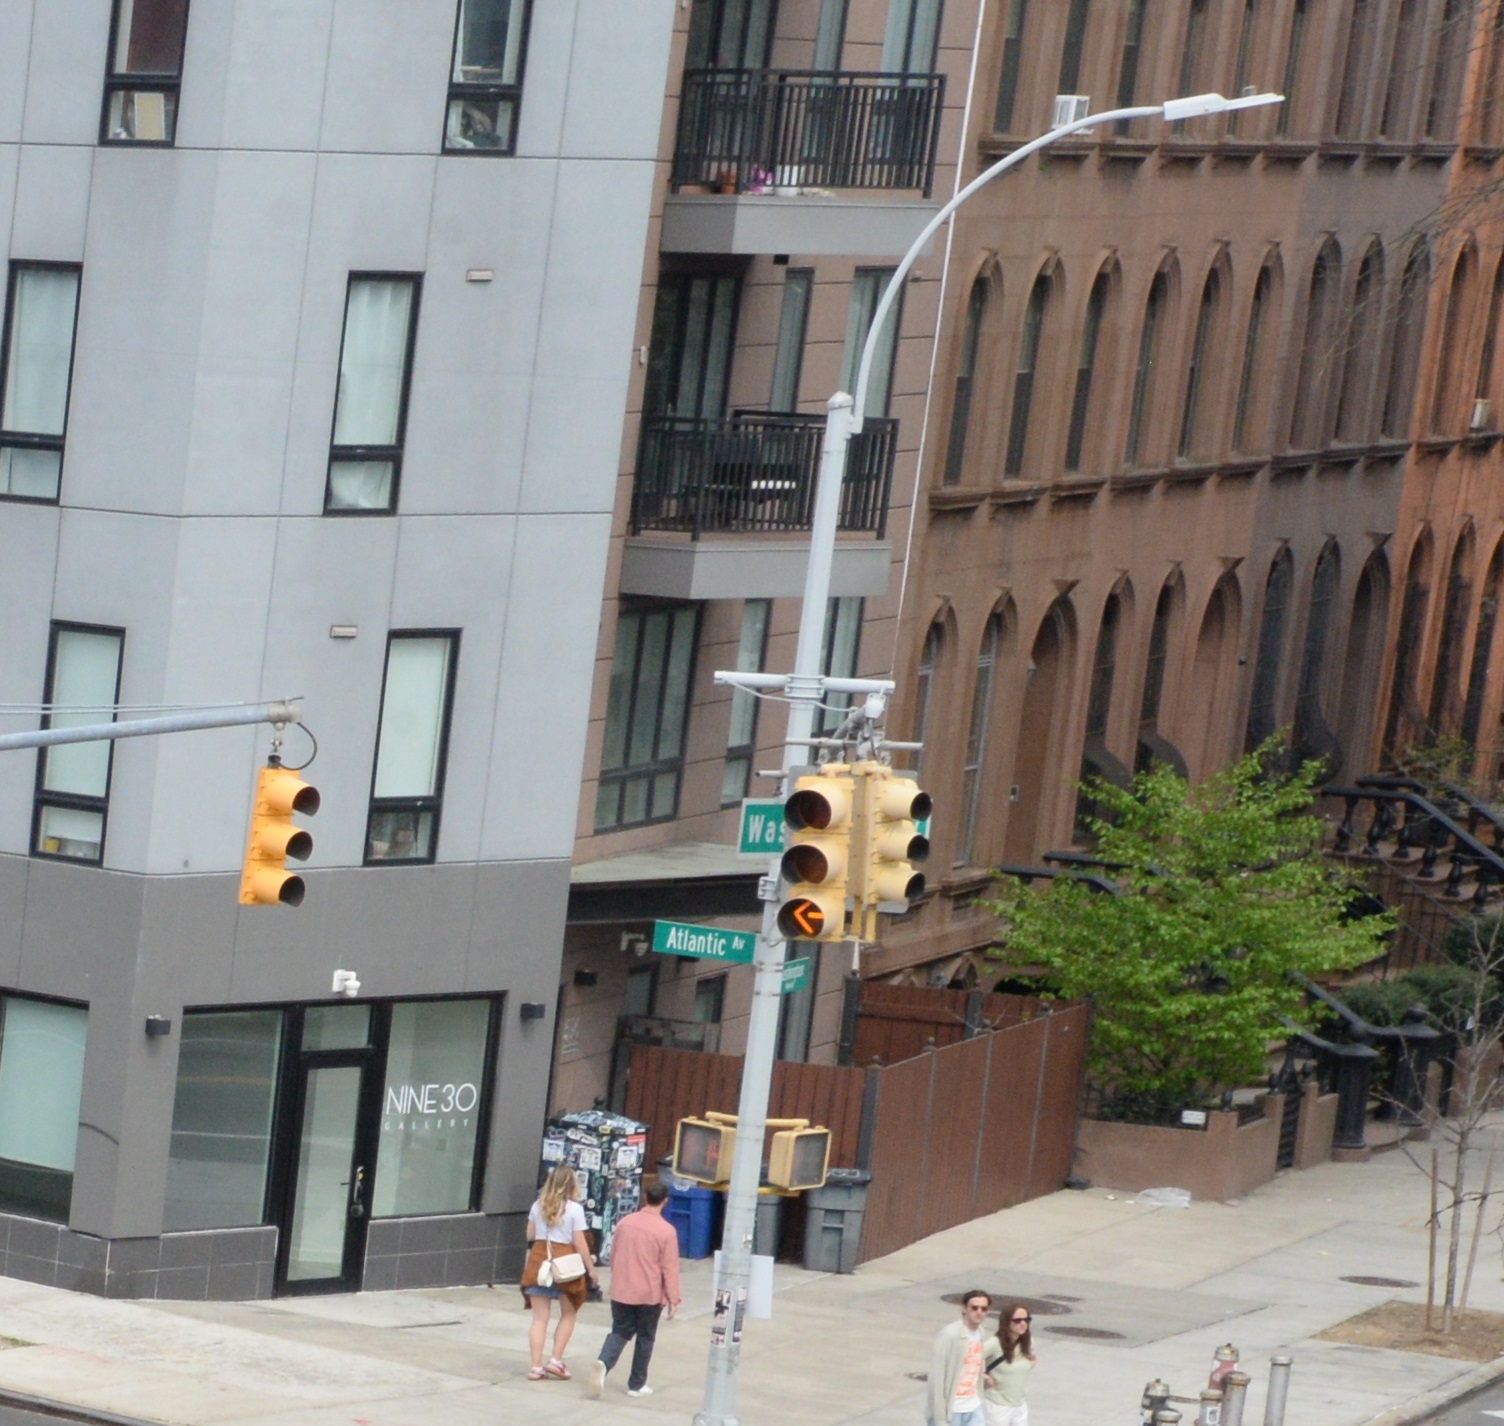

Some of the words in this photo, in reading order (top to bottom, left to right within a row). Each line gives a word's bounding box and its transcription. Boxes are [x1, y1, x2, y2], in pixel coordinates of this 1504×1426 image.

[666, 926, 726, 956] Atlantic
[732, 935, 745, 950] Av
[384, 1118, 469, 1130] GALLERY
